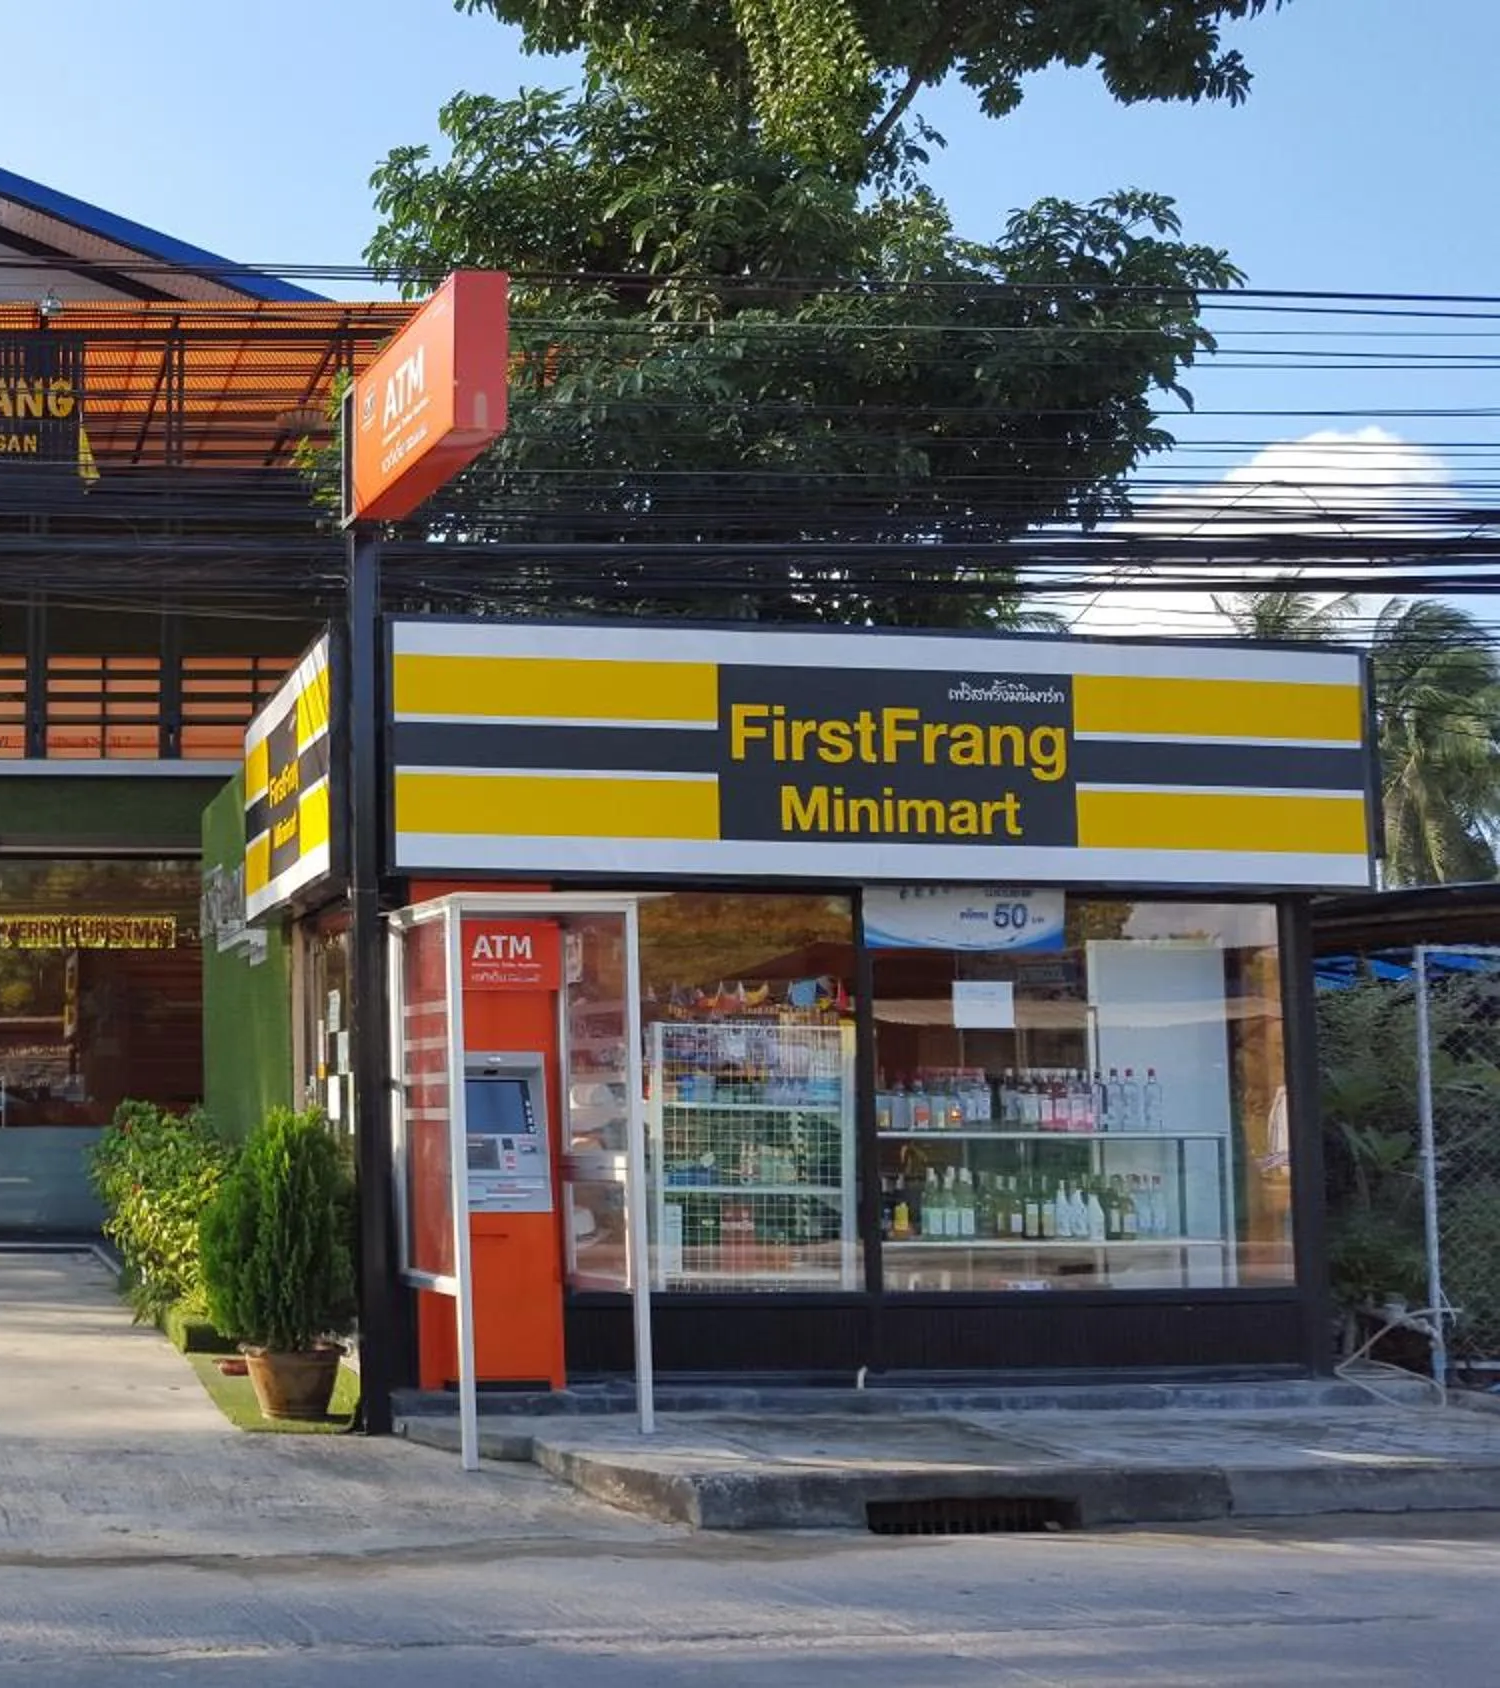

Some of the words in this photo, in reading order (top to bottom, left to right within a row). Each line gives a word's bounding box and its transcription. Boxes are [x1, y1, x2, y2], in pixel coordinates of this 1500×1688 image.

[383, 345, 425, 430] ATM
[731, 703, 1068, 781] FirstFrang
[781, 785, 1024, 836] Minimart
[993, 903, 1028, 929] 50
[472, 935, 533, 959] ATM
